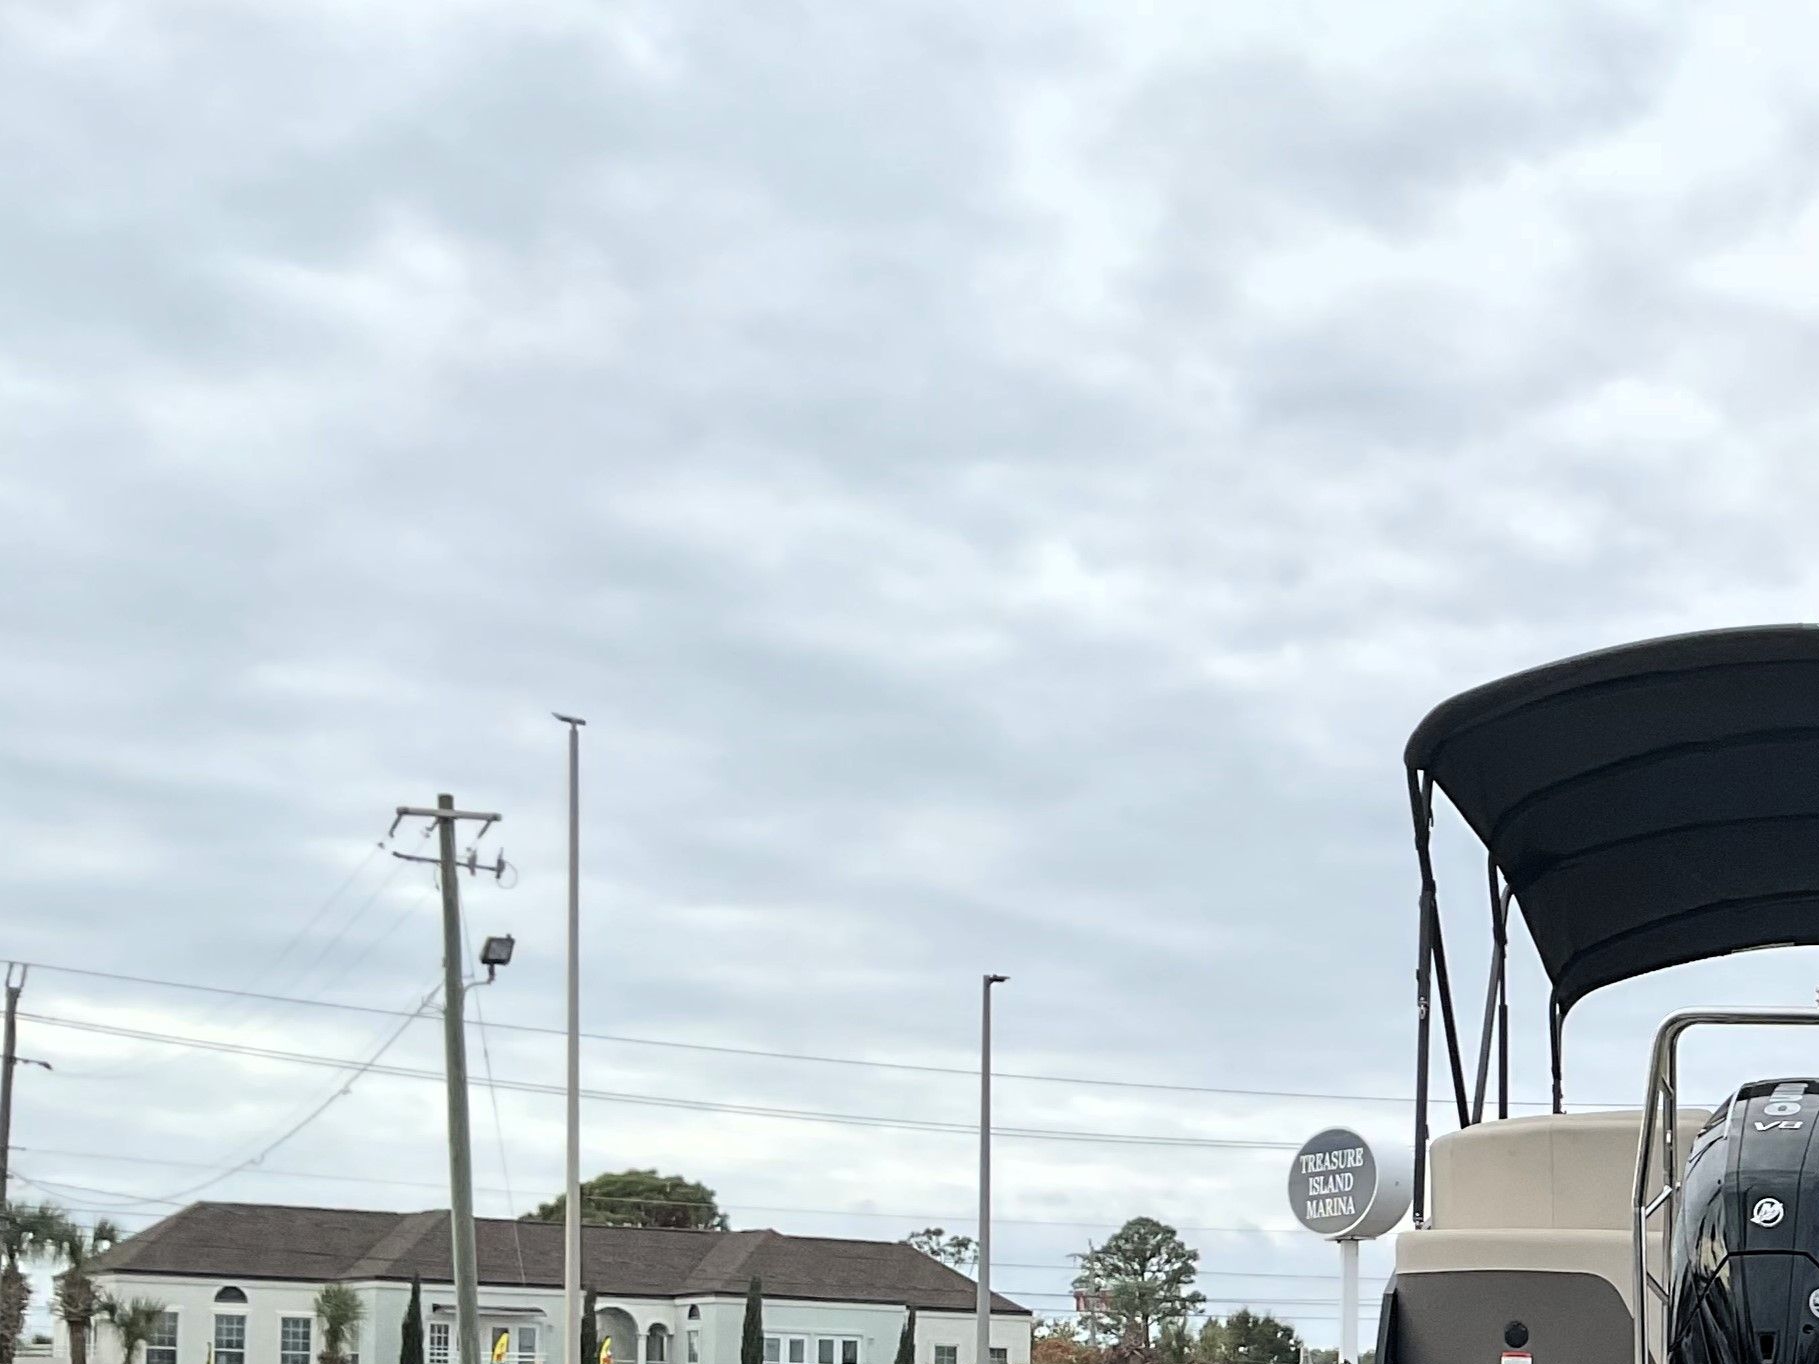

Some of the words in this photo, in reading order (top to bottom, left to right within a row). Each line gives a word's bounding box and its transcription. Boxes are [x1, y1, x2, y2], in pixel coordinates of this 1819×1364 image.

[1300, 1147, 1364, 1174] TREASURE
[1308, 1172, 1354, 1196] ISLAND
[1306, 1196, 1356, 1219] MARINA
